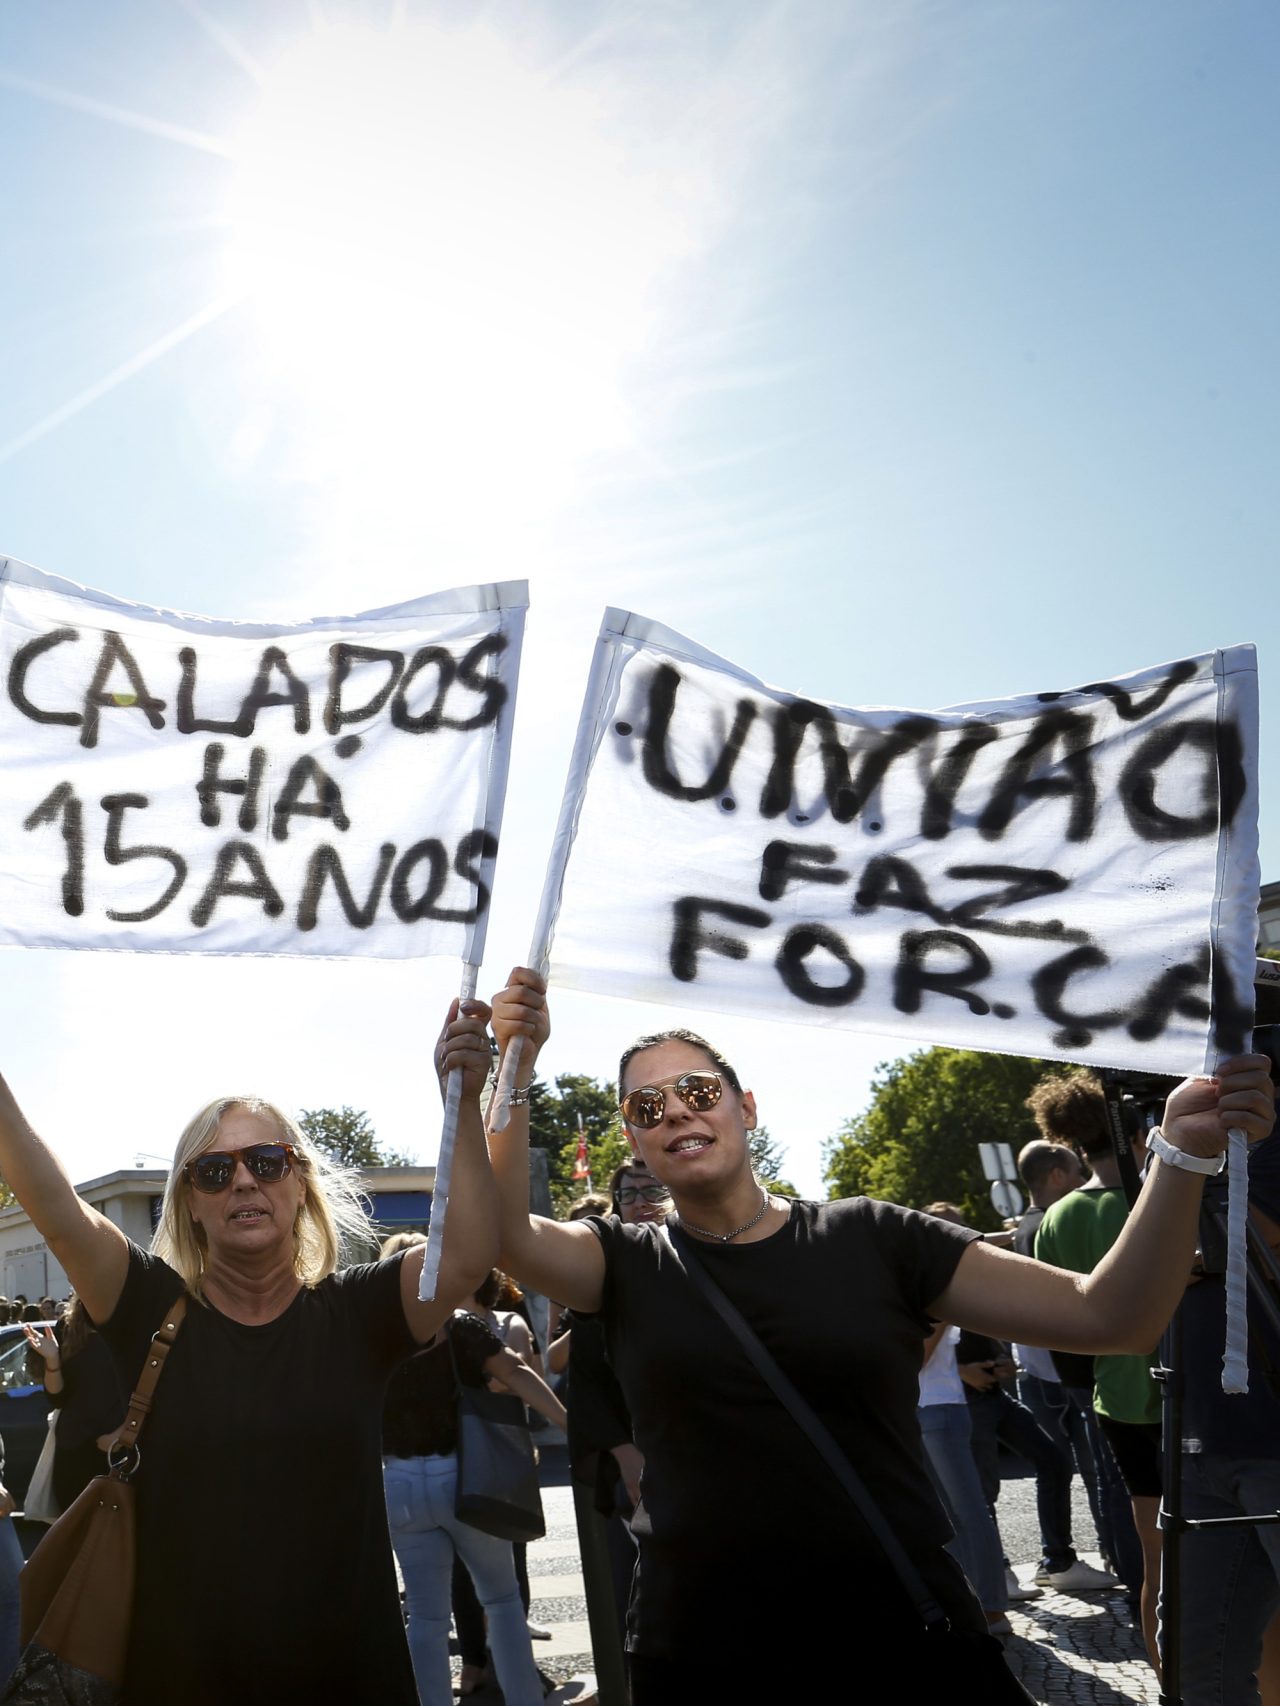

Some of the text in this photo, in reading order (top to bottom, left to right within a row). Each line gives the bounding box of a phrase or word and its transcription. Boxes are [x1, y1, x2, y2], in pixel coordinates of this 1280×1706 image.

[7, 627, 509, 749] CALADOS
[23, 781, 499, 932] 15 ANOS
[758, 840, 1094, 944] FAZ
[1108, 1100, 1129, 1155] Panasonic
